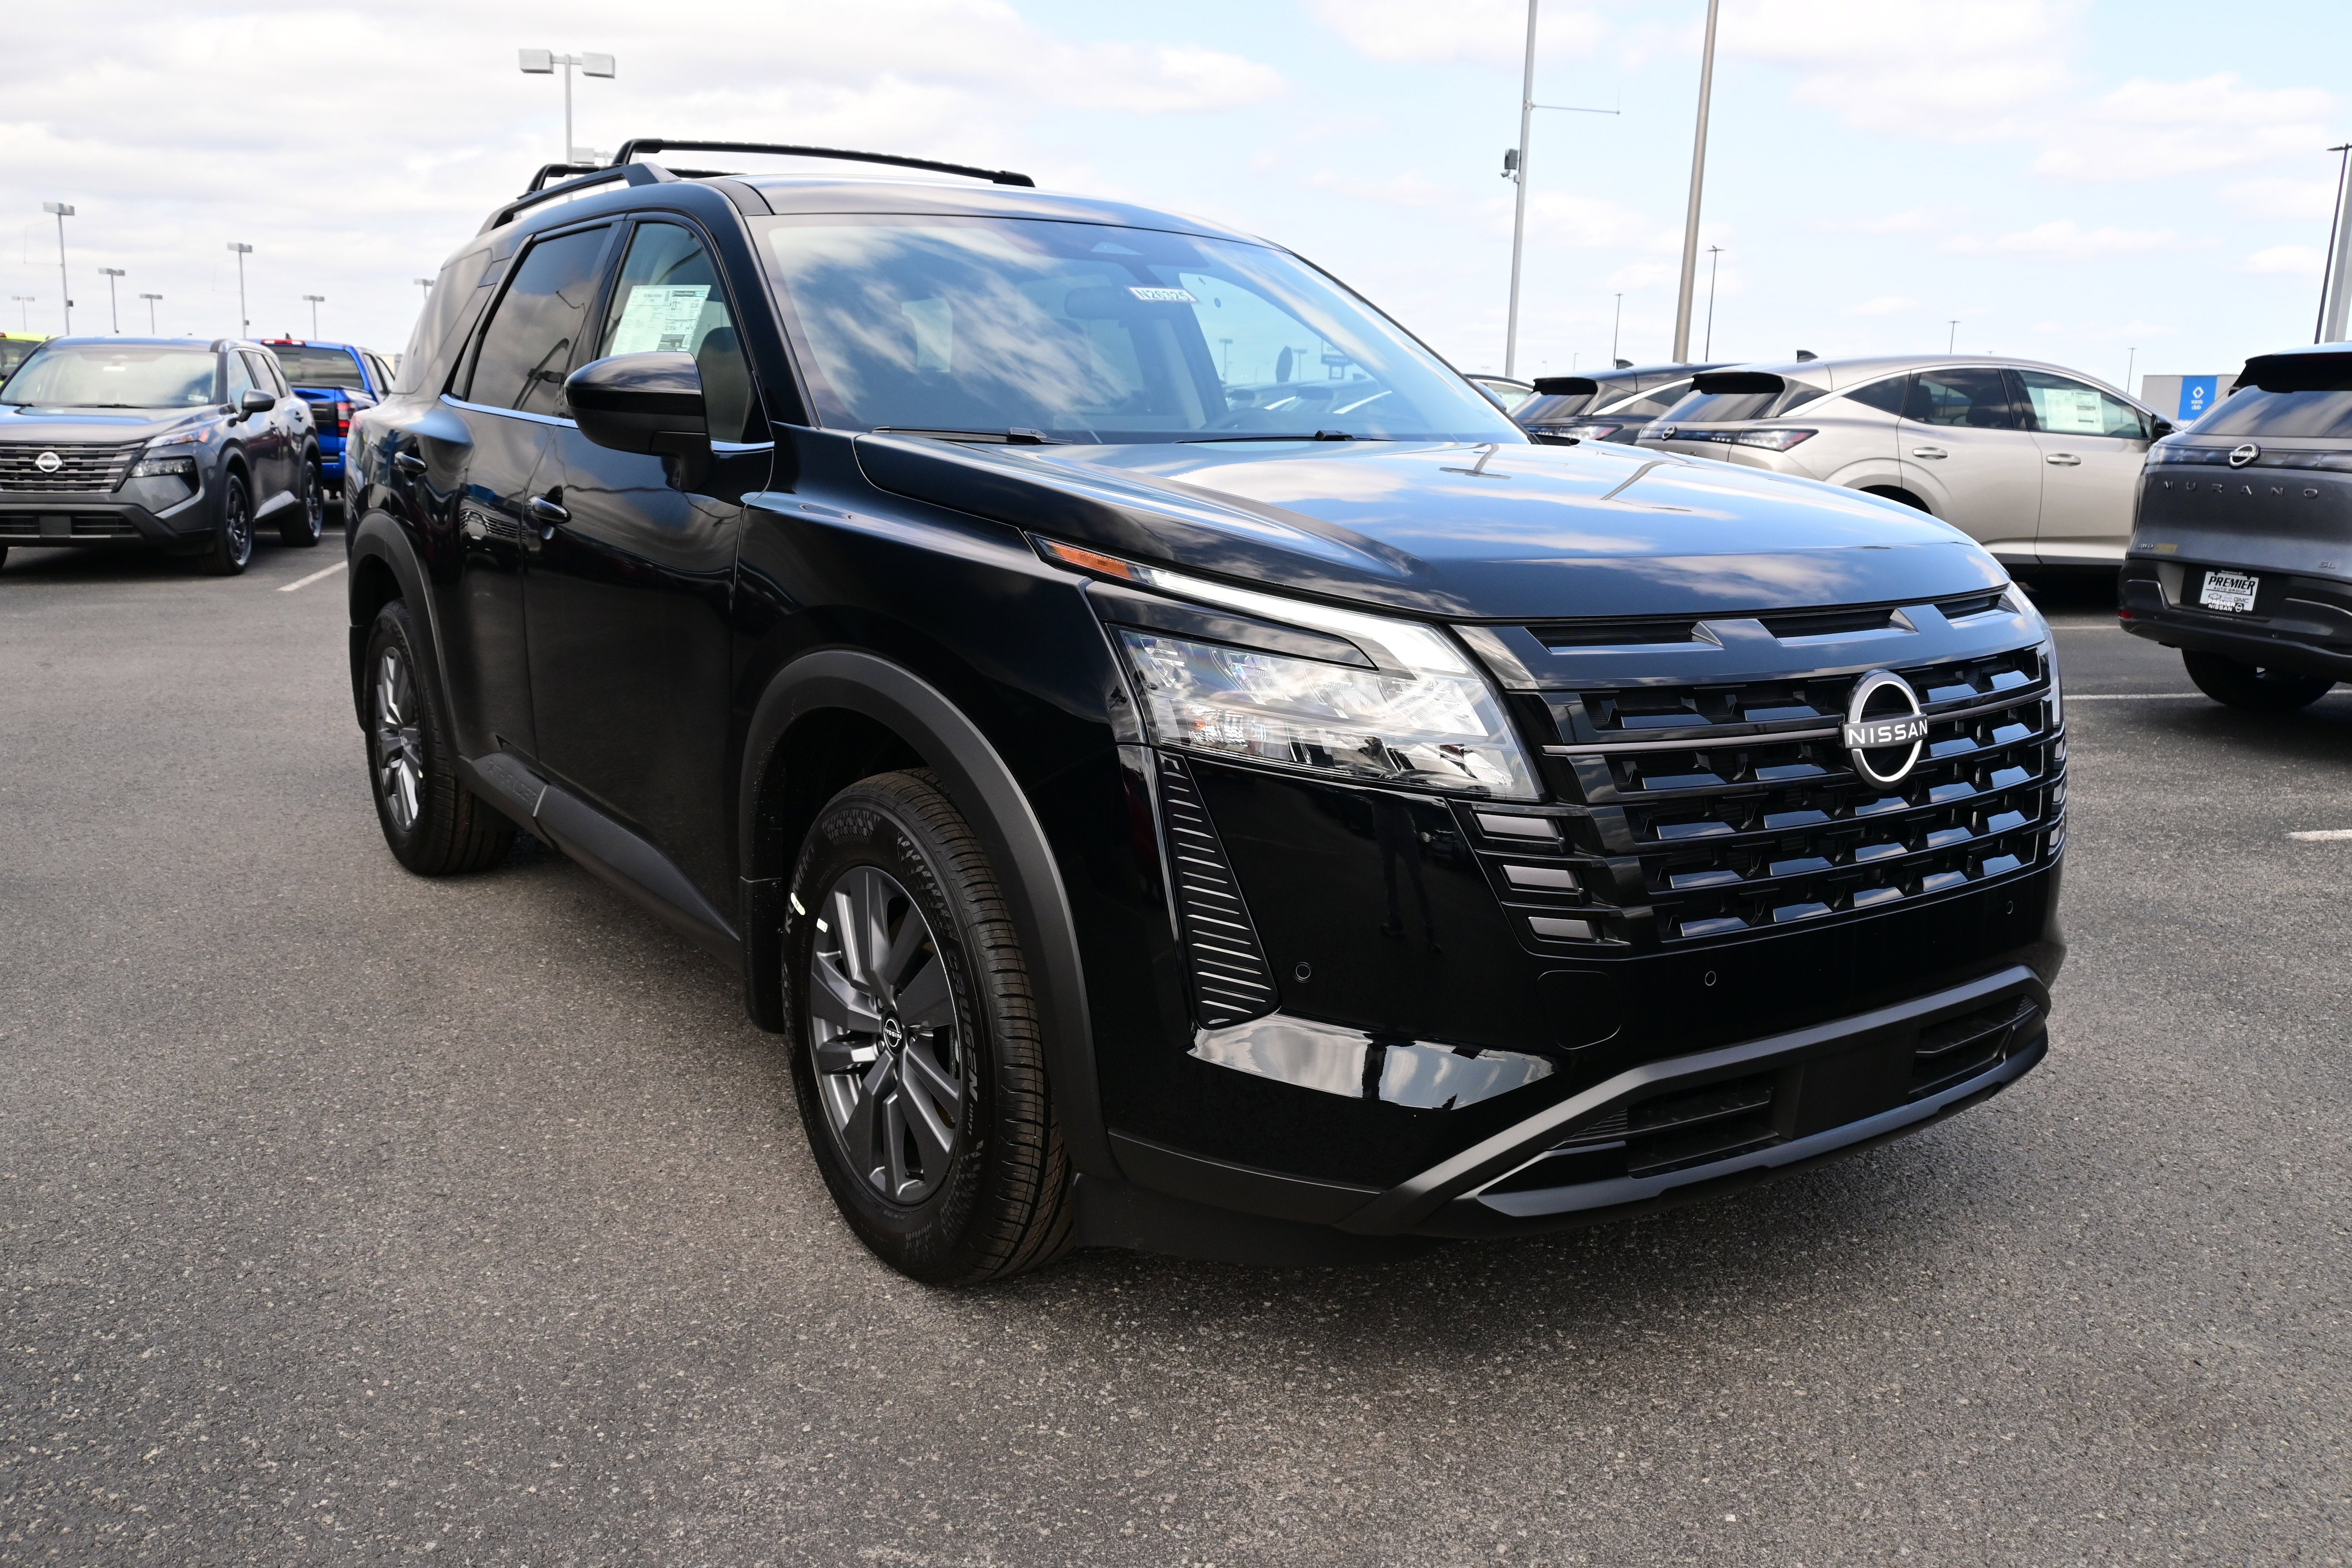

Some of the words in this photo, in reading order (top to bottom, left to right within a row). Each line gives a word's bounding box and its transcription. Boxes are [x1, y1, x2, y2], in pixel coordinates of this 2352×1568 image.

[1134, 289, 1191, 301] N26325
[2164, 481, 2318, 499] MURANO
[2318, 561, 2336, 569] SL
[2208, 576, 2256, 595] PREMIER
[2208, 599, 2236, 608] PREMIER
[2208, 603, 2233, 612] NISSAN
[1848, 719, 1928, 745] NISSAN
[946, 949, 978, 1102] CRUGEN
